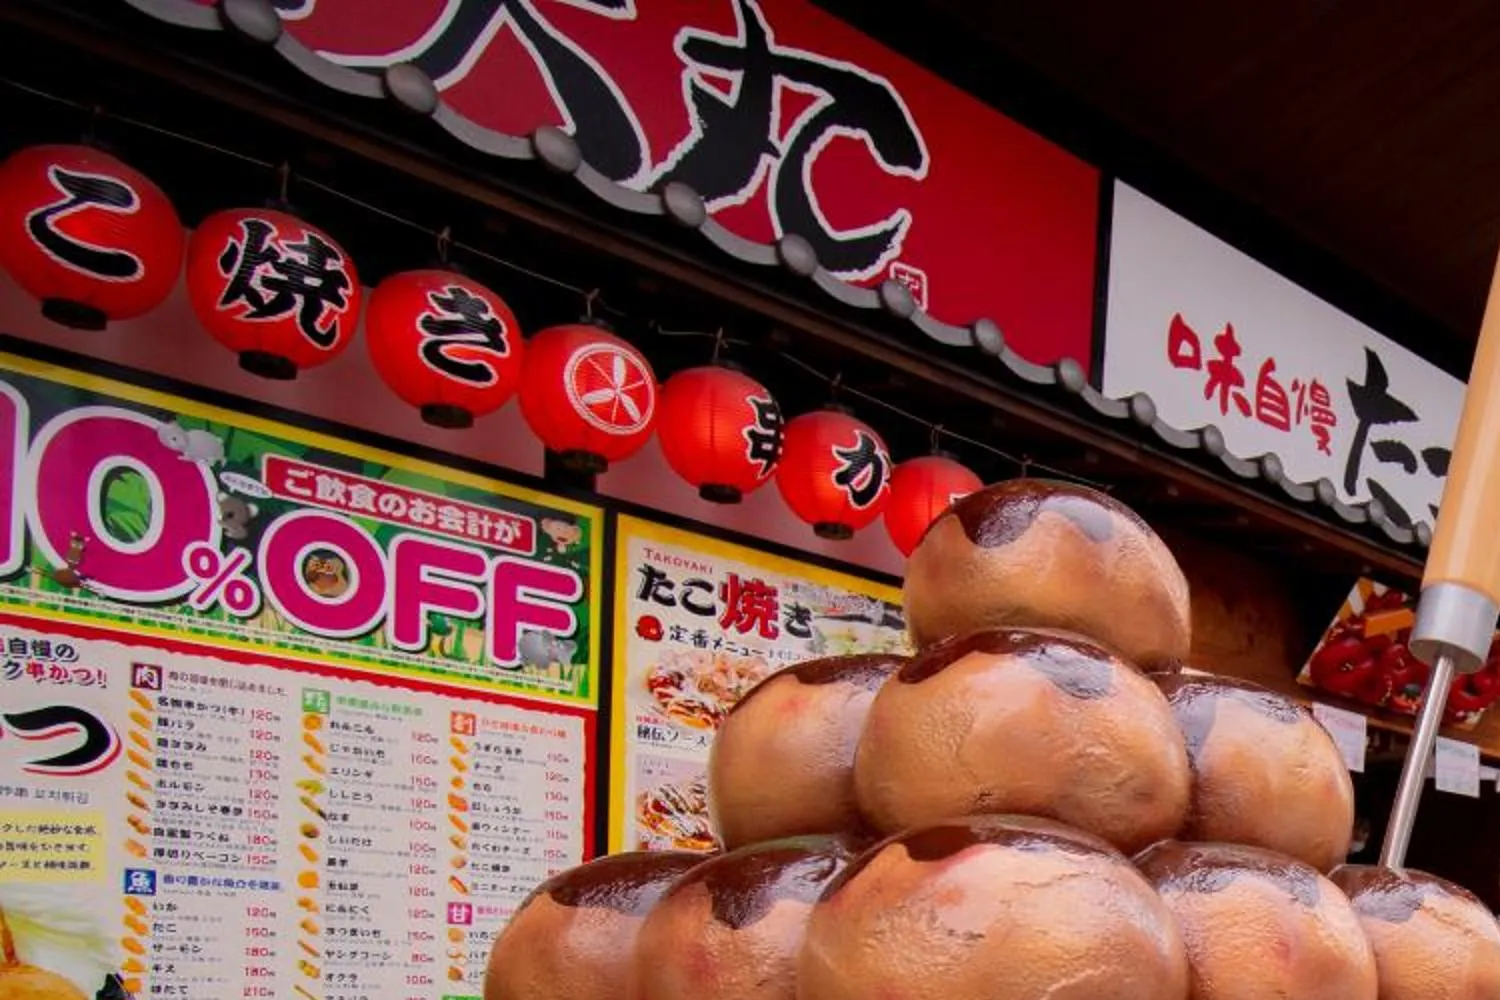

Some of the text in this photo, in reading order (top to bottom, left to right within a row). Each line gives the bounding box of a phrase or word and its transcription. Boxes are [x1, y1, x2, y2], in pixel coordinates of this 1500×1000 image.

[284, 466, 524, 547] ご飲食のお会計が
[642, 547, 714, 576] TAKOYAKI
[635, 563, 814, 641] たこ焼き
